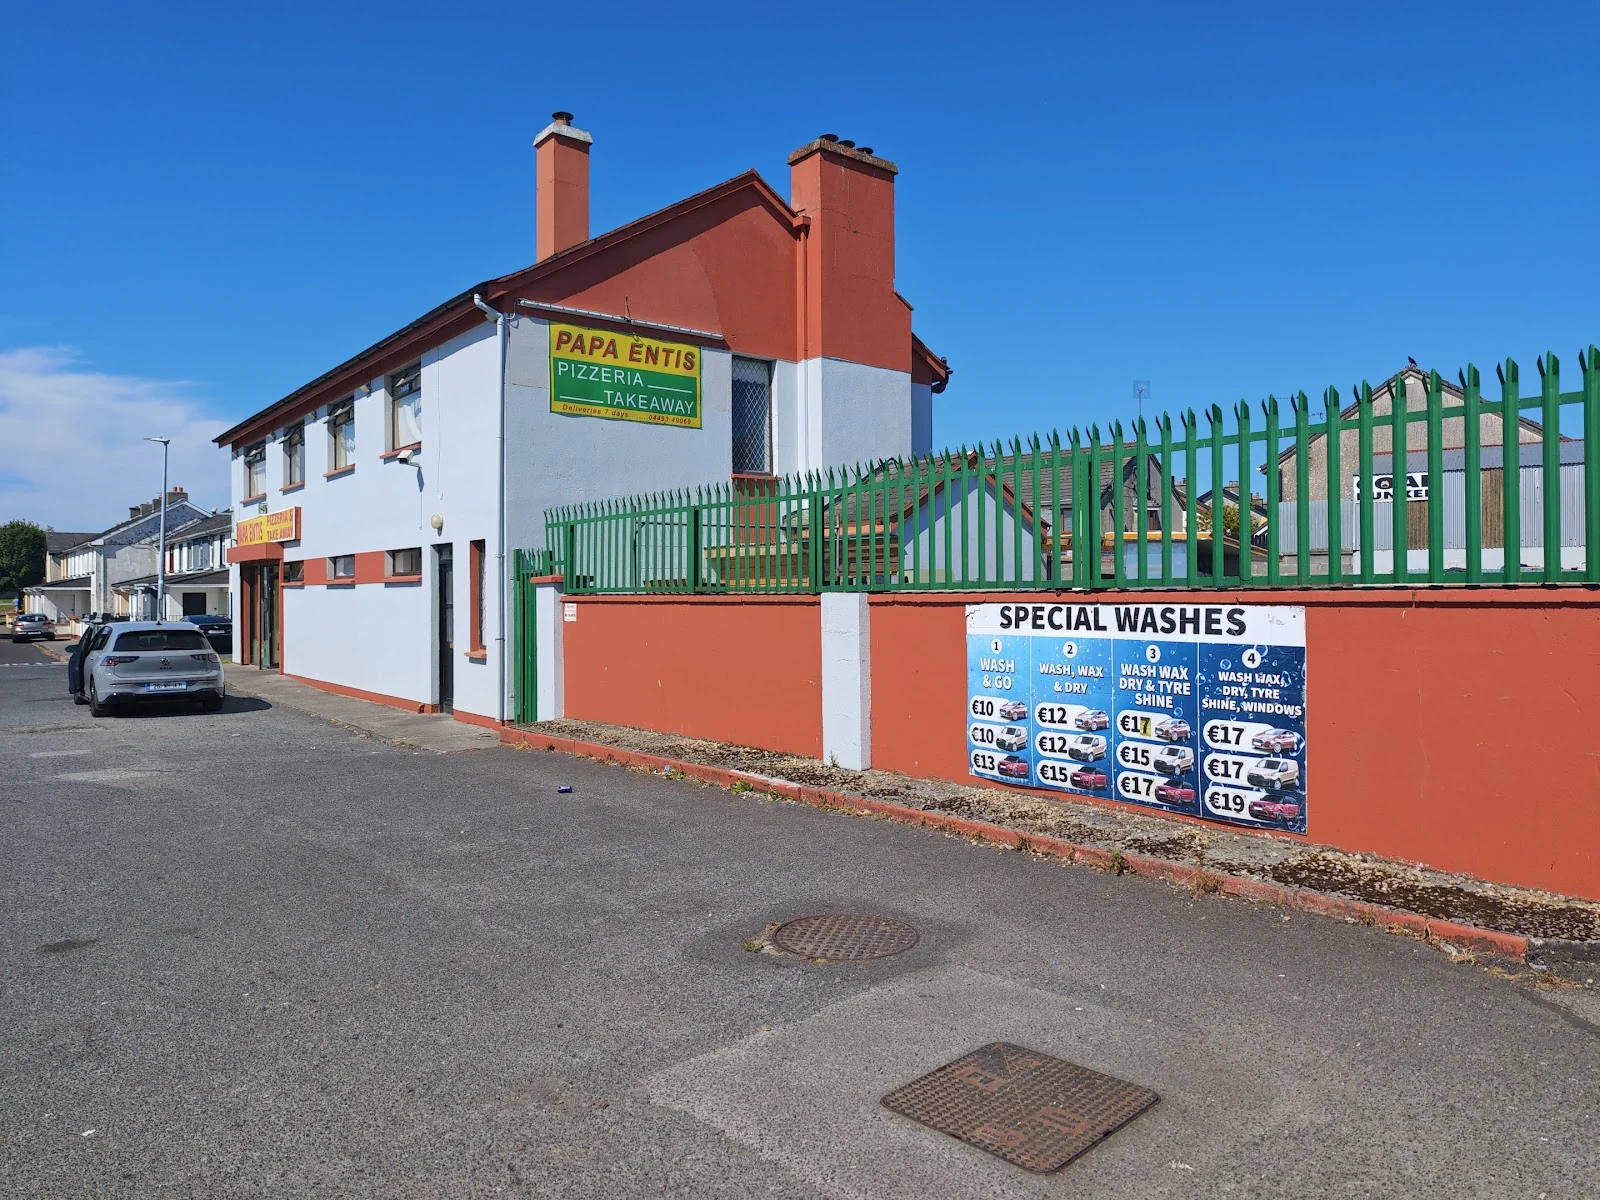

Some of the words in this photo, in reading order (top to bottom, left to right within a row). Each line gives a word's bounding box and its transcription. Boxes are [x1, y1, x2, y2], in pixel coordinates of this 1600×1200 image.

[555, 330, 618, 360] PAPA
[629, 342, 696, 371] ENTIS
[558, 361, 644, 387] PIZZERIA
[562, 403, 602, 415] Deliveries
[611, 409, 629, 419] days
[604, 389, 694, 415] TAKEAWAY
[267, 510, 289, 526] PIZZERIA
[249, 520, 263, 543] ENTIS
[267, 529, 279, 541] TAKE
[280, 525, 293, 539] AWAY
[999, 605, 1107, 633] SPECIAL
[1114, 606, 1247, 637] WASHES
[994, 641, 998, 651] 1
[1067, 644, 1073, 654] 2
[1150, 648, 1156, 659] 3
[980, 657, 1015, 673] WASH
[1247, 652, 1256, 664] 4
[1039, 662, 1075, 679] WASH,
[1077, 665, 1103, 678] WAX
[1120, 663, 1156, 678] WASH
[1159, 665, 1189, 680] WAX
[1218, 671, 1253, 683] WASH
[1255, 673, 1285, 687] WAX,
[983, 674, 992, 688] &
[994, 675, 1012, 690] GO
[1053, 681, 1062, 693] &
[1065, 682, 1088, 694] DRY
[1119, 677, 1143, 692] DRY
[1145, 679, 1156, 692] &
[1157, 680, 1191, 696] TYRE
[1135, 693, 1174, 709] SHINE
[1222, 685, 1248, 699] DRY,
[1250, 687, 1280, 700] TYRE
[971, 699, 994, 717] €10
[1038, 707, 1068, 724] €12
[1201, 698, 1240, 713] SHINE,
[1242, 701, 1302, 717] WINDOWS
[1120, 714, 1150, 734] €17
[971, 726, 994, 744] €10
[1207, 725, 1245, 746] €17
[1038, 735, 1068, 754] €12
[973, 753, 995, 771] €13
[1120, 745, 1150, 766] €15
[1040, 764, 1068, 783] €15
[1207, 758, 1244, 779] €17
[1120, 776, 1154, 796] €17
[1208, 791, 1245, 813] €19
